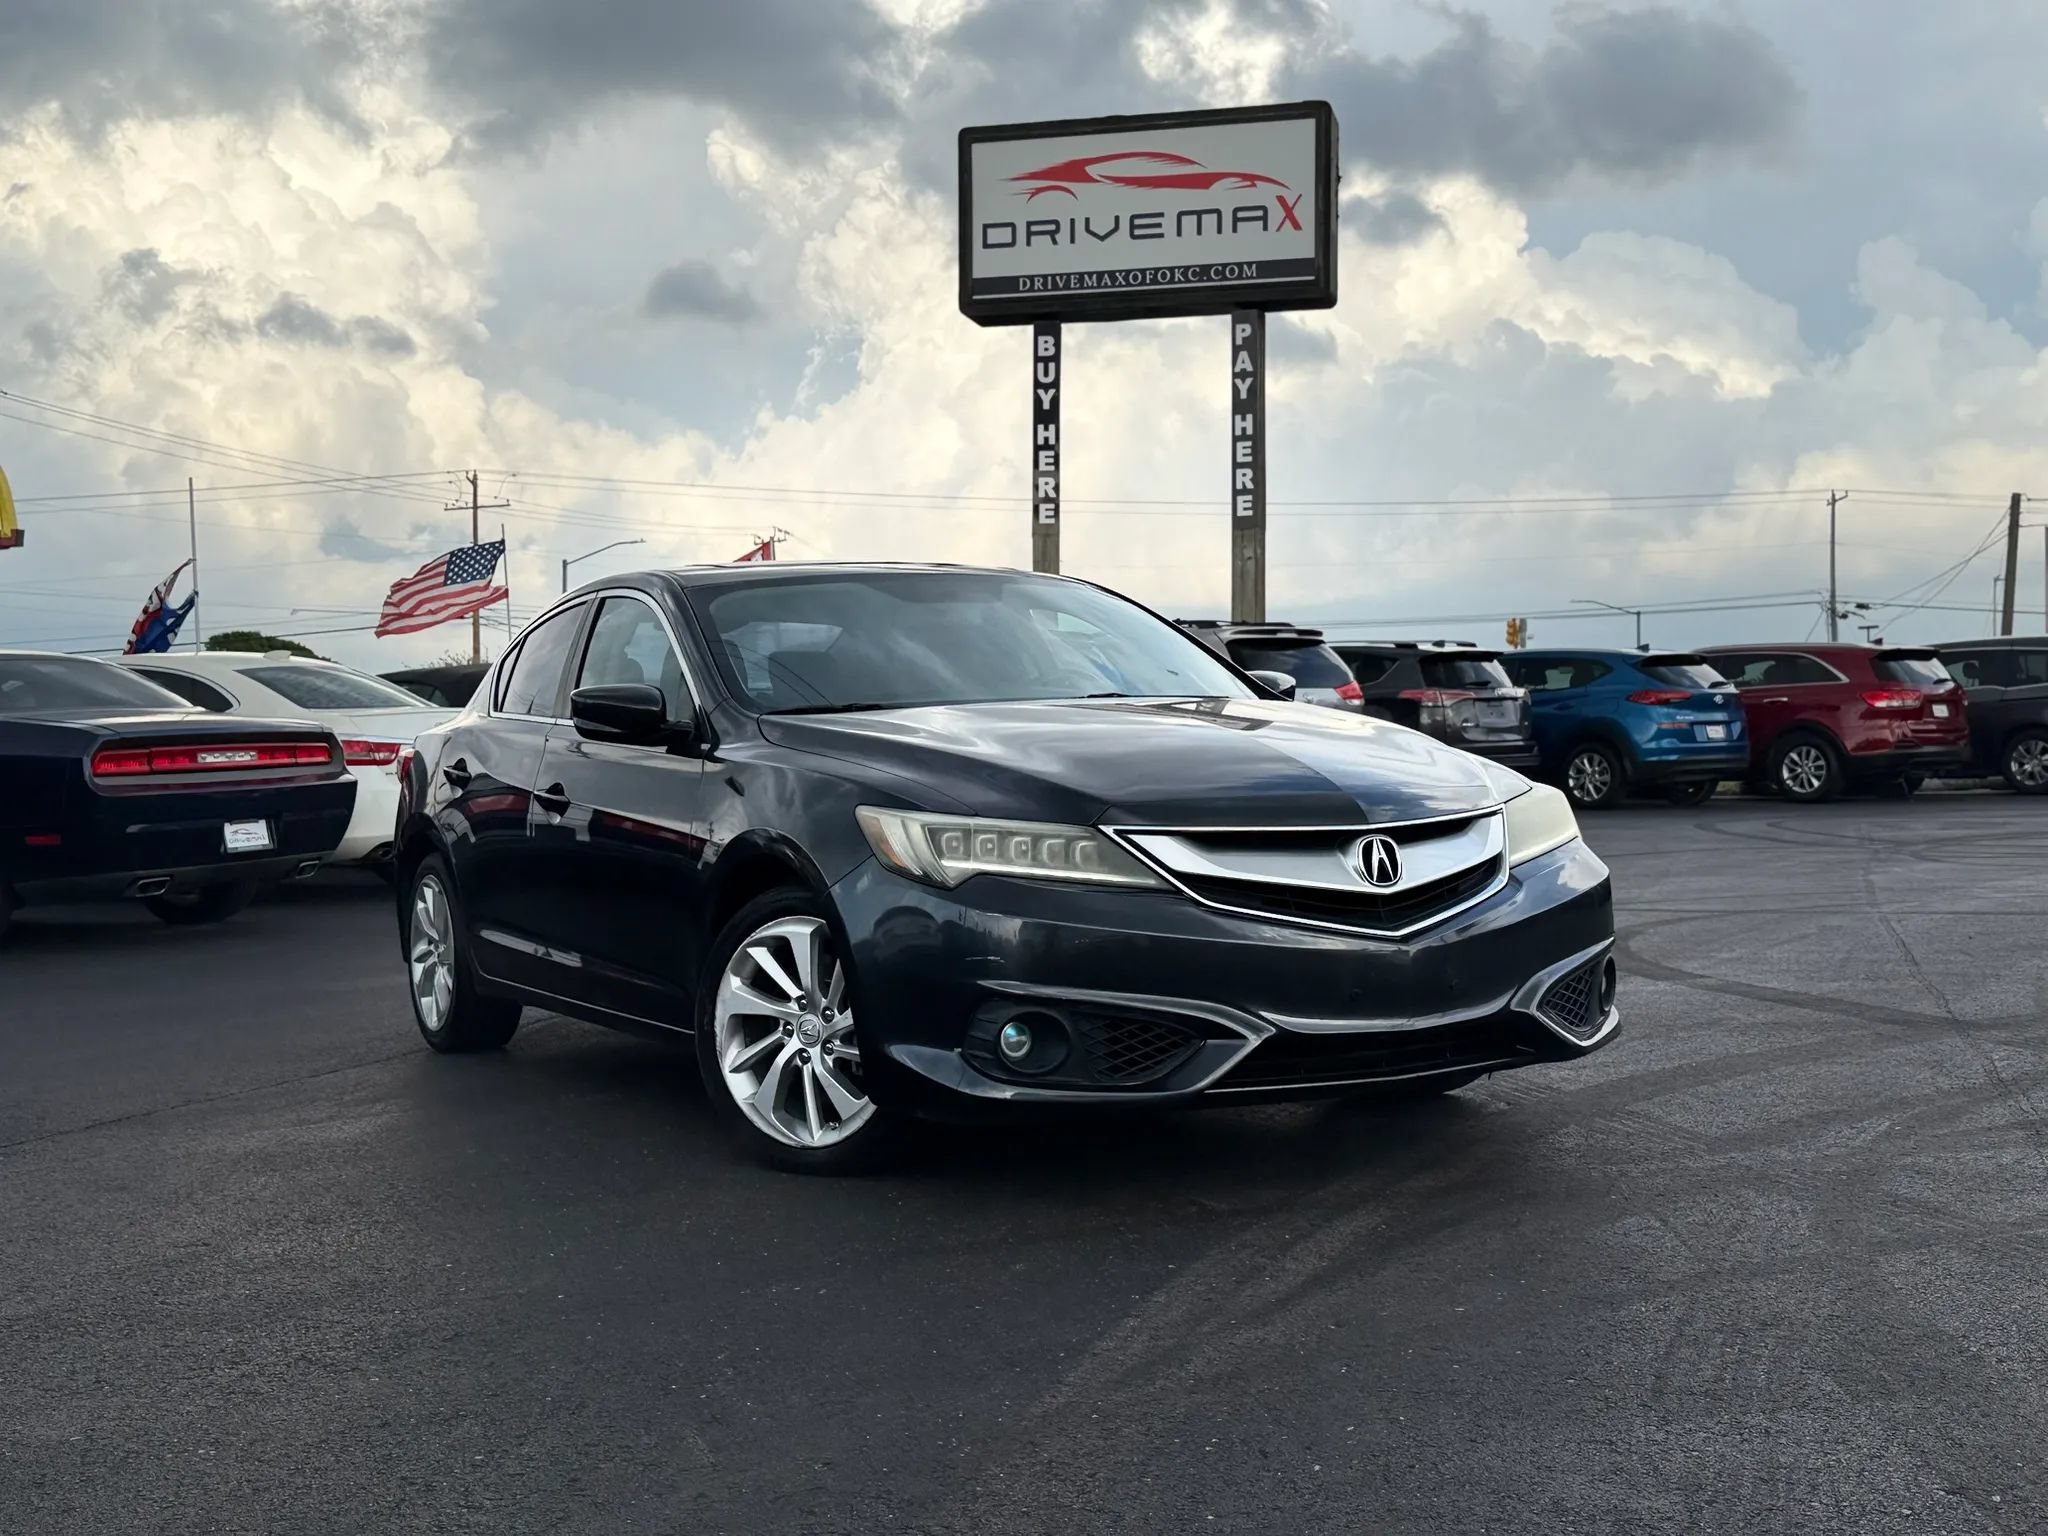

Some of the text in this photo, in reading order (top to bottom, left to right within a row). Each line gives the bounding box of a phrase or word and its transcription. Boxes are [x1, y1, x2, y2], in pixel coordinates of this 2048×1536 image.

[982, 194, 1303, 249] DRIVEMAX
[1019, 264, 1258, 291] DRIVEMAXOFOKC.COM
[1037, 336, 1057, 524] BUY HERE
[1234, 324, 1254, 516] PAY HERE
